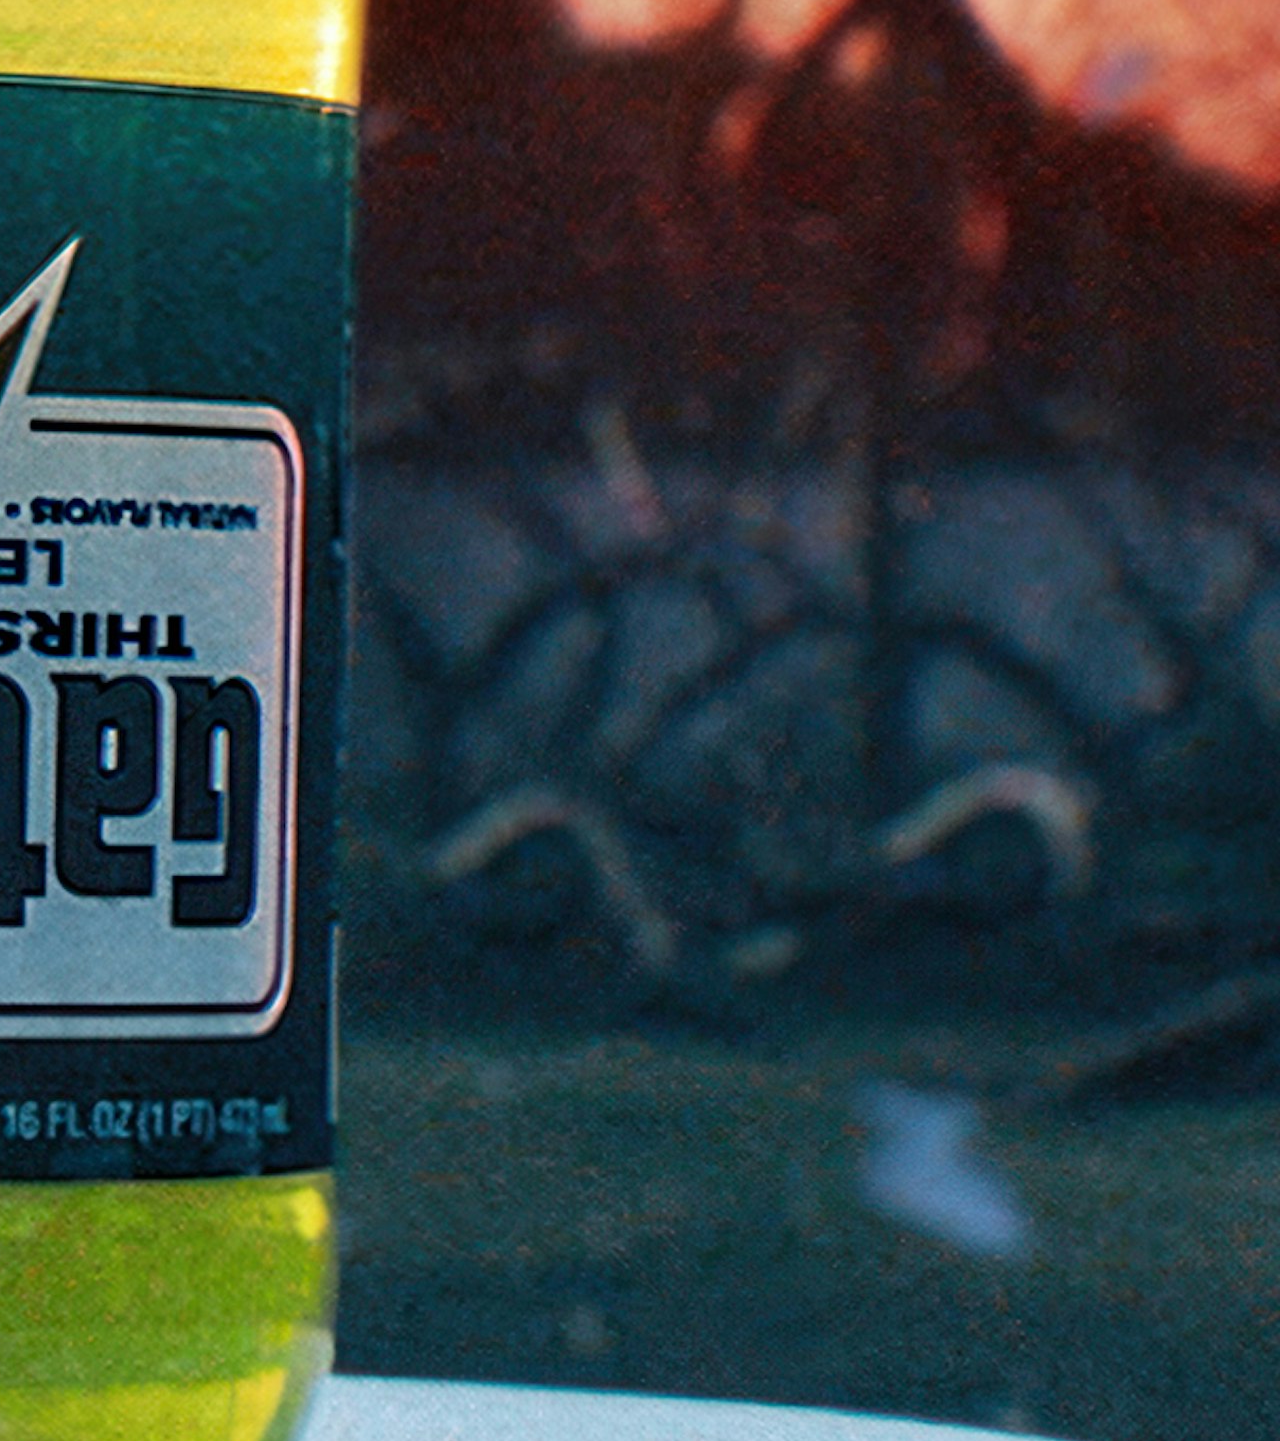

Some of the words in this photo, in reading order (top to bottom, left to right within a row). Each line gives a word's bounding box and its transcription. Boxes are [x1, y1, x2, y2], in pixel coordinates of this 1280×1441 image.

[30, 495, 152, 525] FLAVORS
[0, 1099, 40, 1141] 16
[48, 1099, 88, 1140] FL
